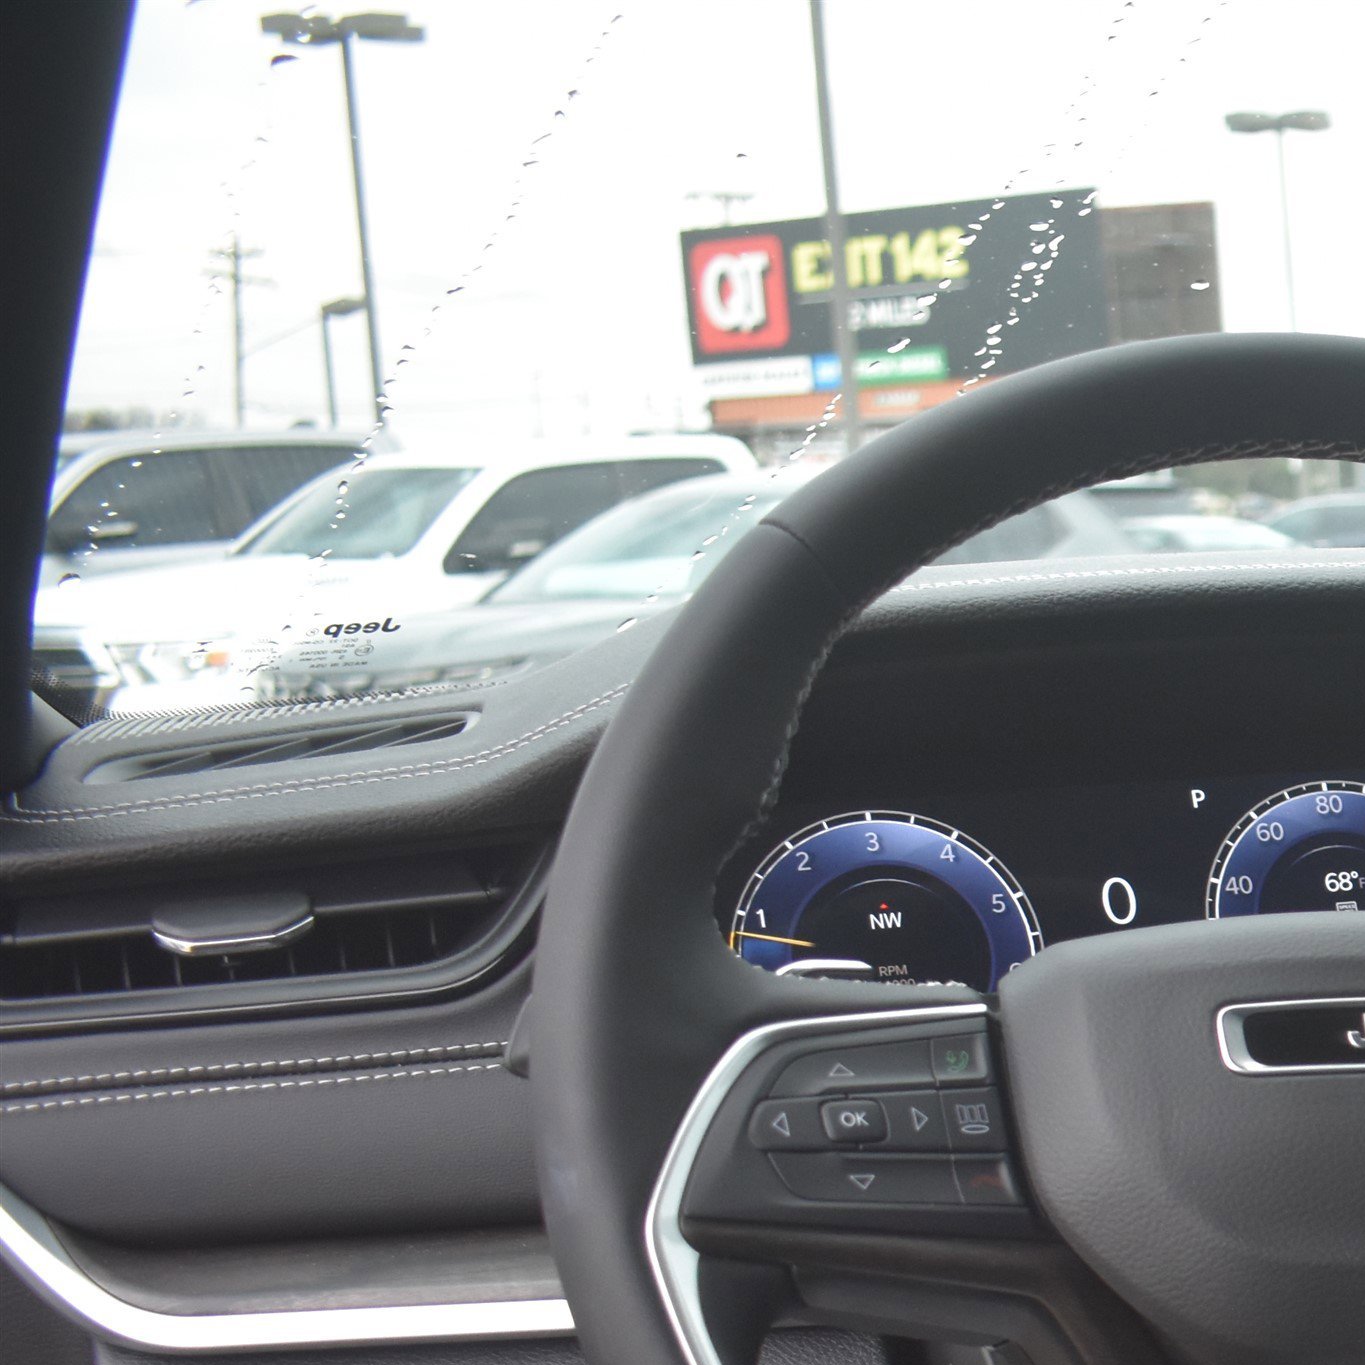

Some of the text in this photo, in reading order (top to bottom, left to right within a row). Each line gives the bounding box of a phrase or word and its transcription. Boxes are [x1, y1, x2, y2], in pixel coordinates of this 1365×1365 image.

[892, 225, 970, 282] 142
[703, 250, 770, 333] QT
[1190, 789, 1206, 809] P
[1315, 795, 1343, 815] 80
[865, 832, 880, 851] 3
[1256, 822, 1284, 842] 60
[797, 852, 812, 872] 2
[940, 844, 956, 862] 4
[1225, 875, 1253, 896] 40
[991, 894, 1006, 913] 5
[1101, 876, 1138, 925] 0
[755, 908, 767, 928] 1
[869, 912, 902, 930] NW
[879, 965, 908, 977] RPM
[840, 1112, 869, 1127] OK
